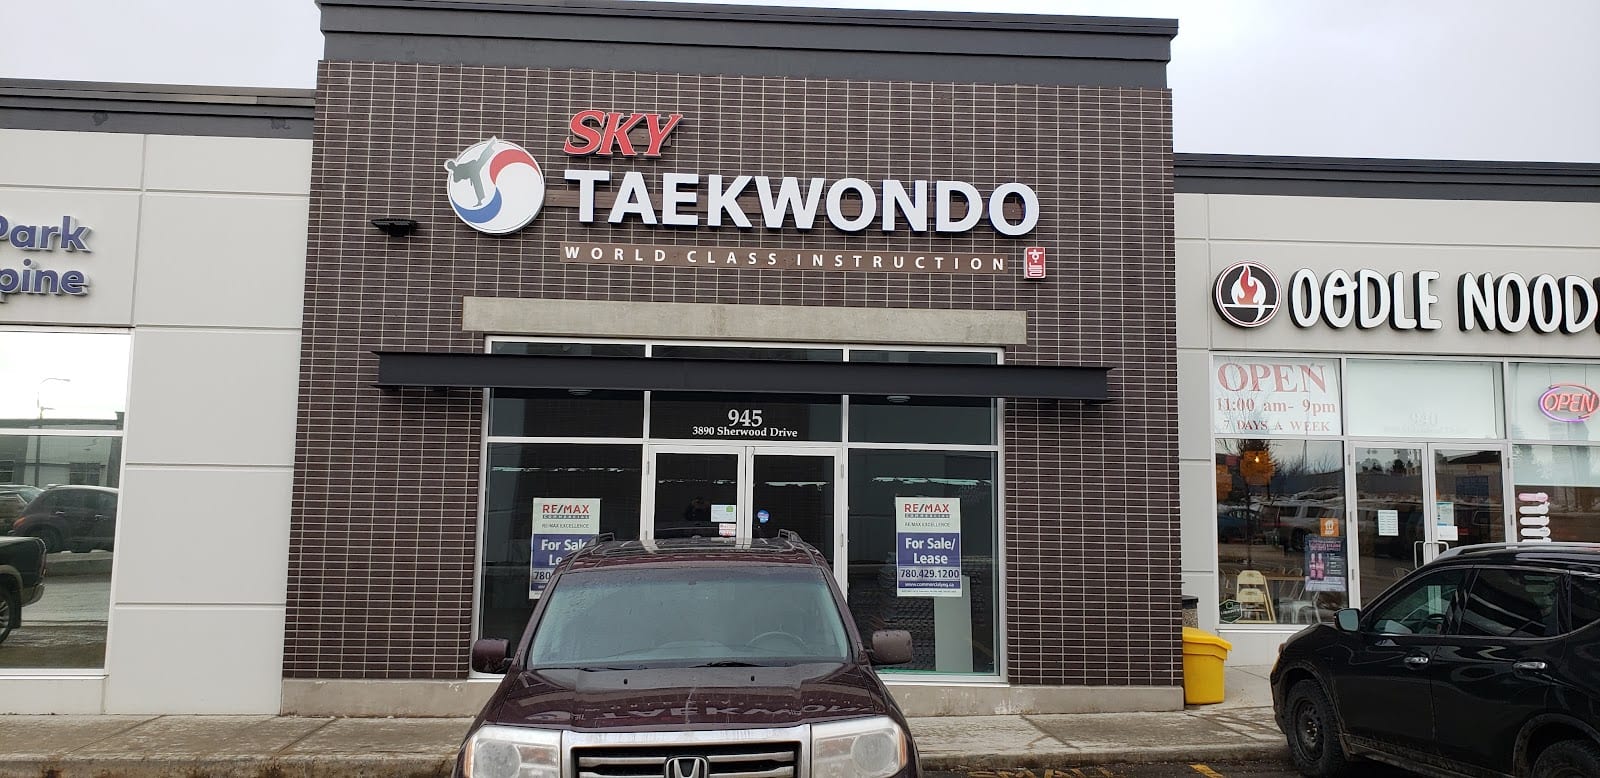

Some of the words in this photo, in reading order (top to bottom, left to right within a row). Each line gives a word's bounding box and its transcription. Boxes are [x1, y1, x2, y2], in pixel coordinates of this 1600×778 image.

[563, 109, 683, 156] SKY
[564, 169, 1041, 236] TAEKWONDO
[565, 246, 666, 262] WORLD
[686, 250, 777, 265] CLASS
[796, 253, 1004, 270] INSTRUCTION
[1289, 267, 1443, 329] OODLE
[1458, 271, 1600, 334] NOOD
[1217, 362, 1327, 393] OPEN
[1216, 397, 1255, 412] 11:00
[1302, 399, 1336, 416] 9pm
[1544, 393, 1596, 412] OPEN
[727, 409, 763, 426] 945
[692, 426, 715, 436] 3890
[716, 426, 767, 437] Sherwood
[769, 427, 798, 437] Drive
[1224, 420, 1231, 430] 7
[1236, 420, 1268, 431] DAYS
[1275, 421, 1283, 431] A
[1290, 421, 1330, 432] WEEK
[542, 504, 590, 514] RE/MAX
[904, 503, 950, 513] RE/MAX
[541, 539, 561, 551] For
[905, 538, 924, 549] For
[927, 538, 956, 551] Sale/
[548, 554, 563, 566] Le
[913, 552, 949, 565] Lease
[900, 569, 960, 578] 780.429.1200
